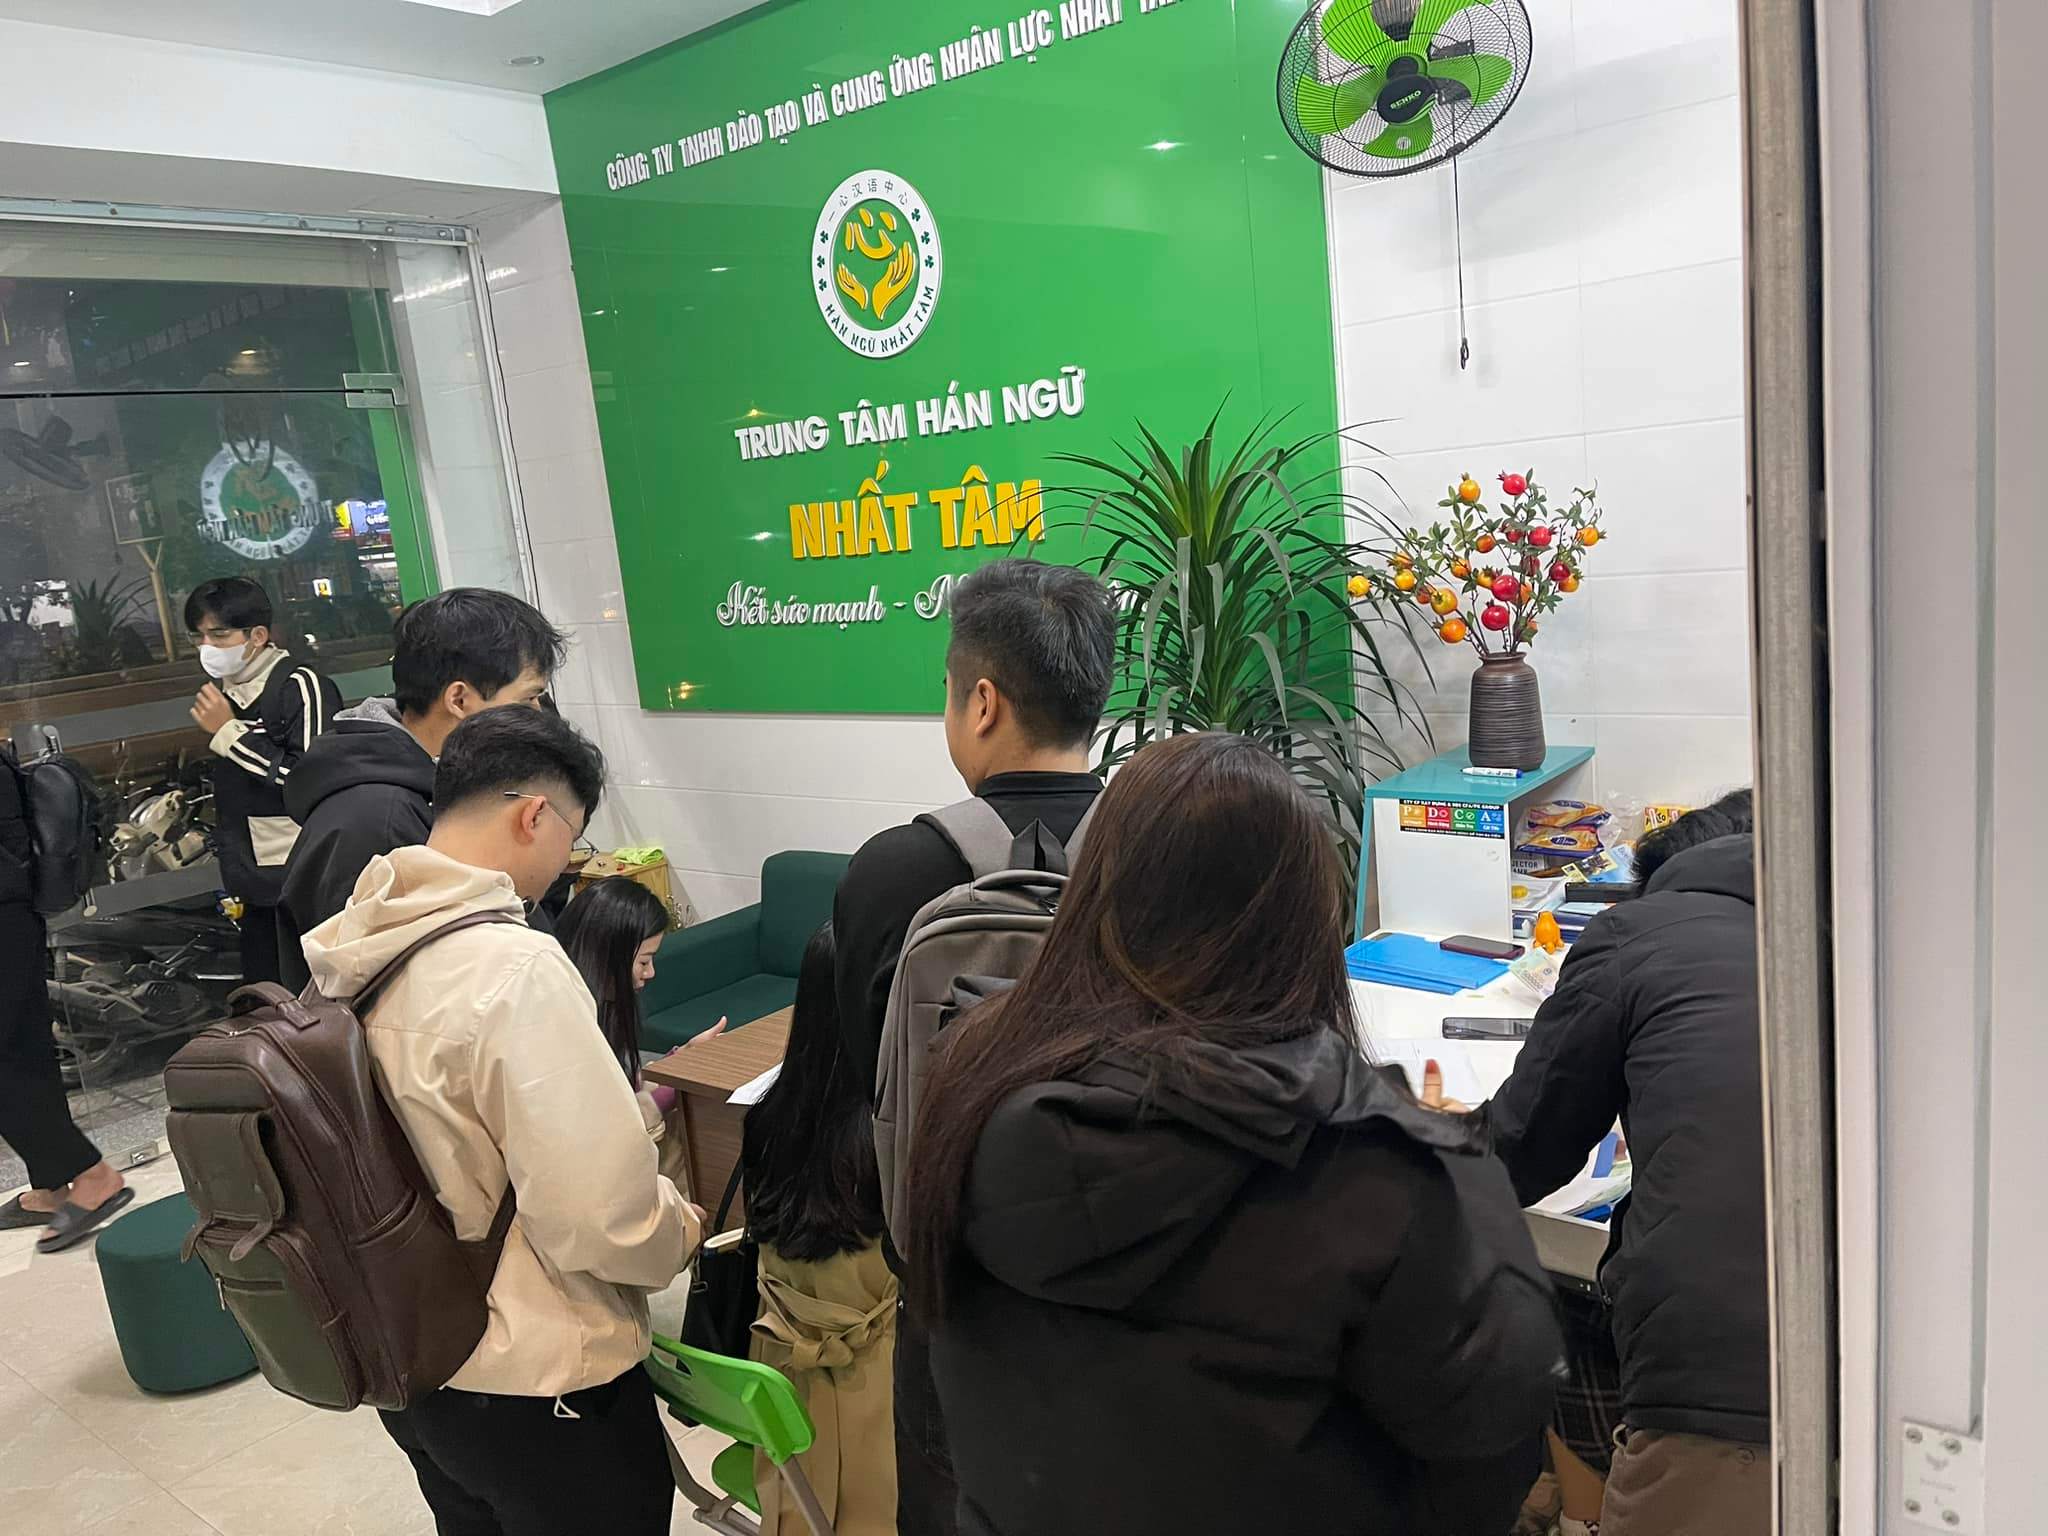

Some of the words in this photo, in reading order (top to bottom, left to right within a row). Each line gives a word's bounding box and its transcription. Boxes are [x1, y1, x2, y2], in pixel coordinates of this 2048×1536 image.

[606, 152, 651, 191] CÔNG
[651, 143, 674, 176] TY
[678, 126, 725, 168] TNHH
[726, 109, 763, 152] ĐÀO
[764, 99, 800, 145] TẠO
[801, 83, 830, 127] VÀ
[830, 70, 887, 117] CUNG
[888, 54, 937, 98] ỨNG
[939, 25, 1004, 81] NHÂN
[1007, 9, 1055, 64] LỰC
[734, 415, 829, 460] TRUNG
[837, 398, 909, 446] TÂM
[916, 380, 993, 436] HÁN
[1001, 365, 1086, 423] NGỮ
[789, 459, 918, 559] NHẤT
[929, 464, 1046, 548] TÂM
[716, 580, 768, 627] Kết
[770, 595, 810, 625] sức
[812, 584, 886, 631] mạnh
[1428, 808, 1438, 818] D
[1454, 809, 1464, 820] C
[1481, 811, 1491, 822] A
